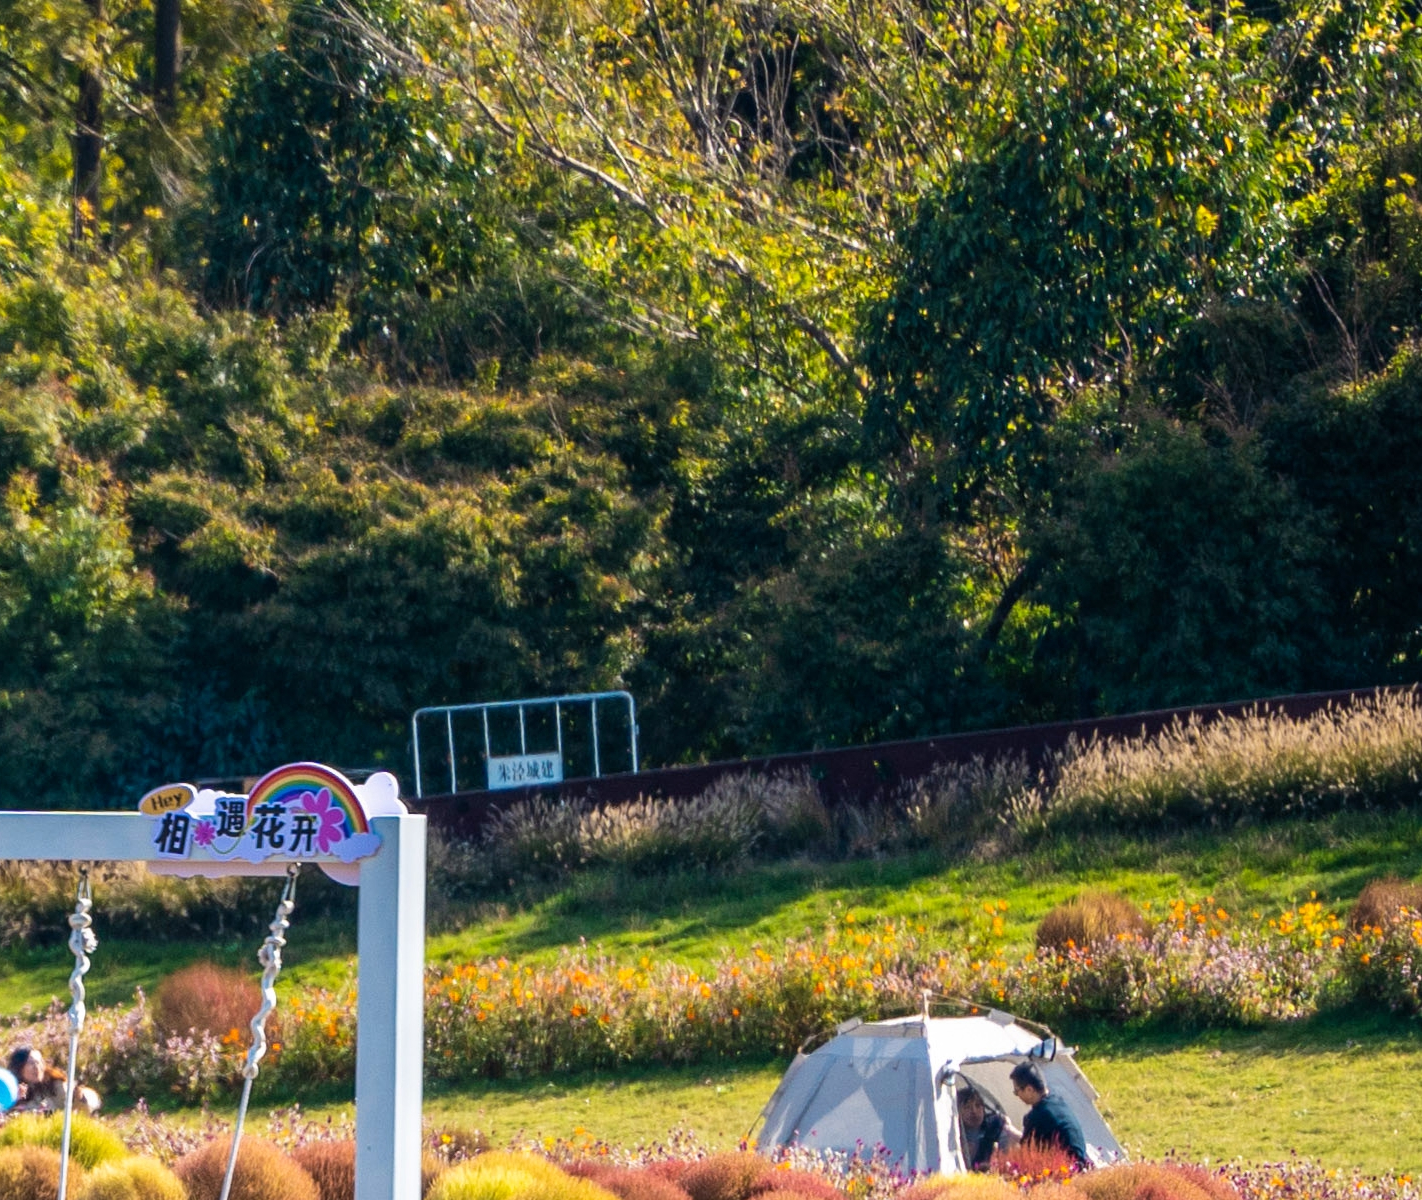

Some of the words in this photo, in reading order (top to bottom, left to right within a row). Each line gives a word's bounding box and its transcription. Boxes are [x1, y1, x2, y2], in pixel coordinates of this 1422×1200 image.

[152, 794, 182, 811] Hey
[155, 802, 317, 855] 相遇花开
